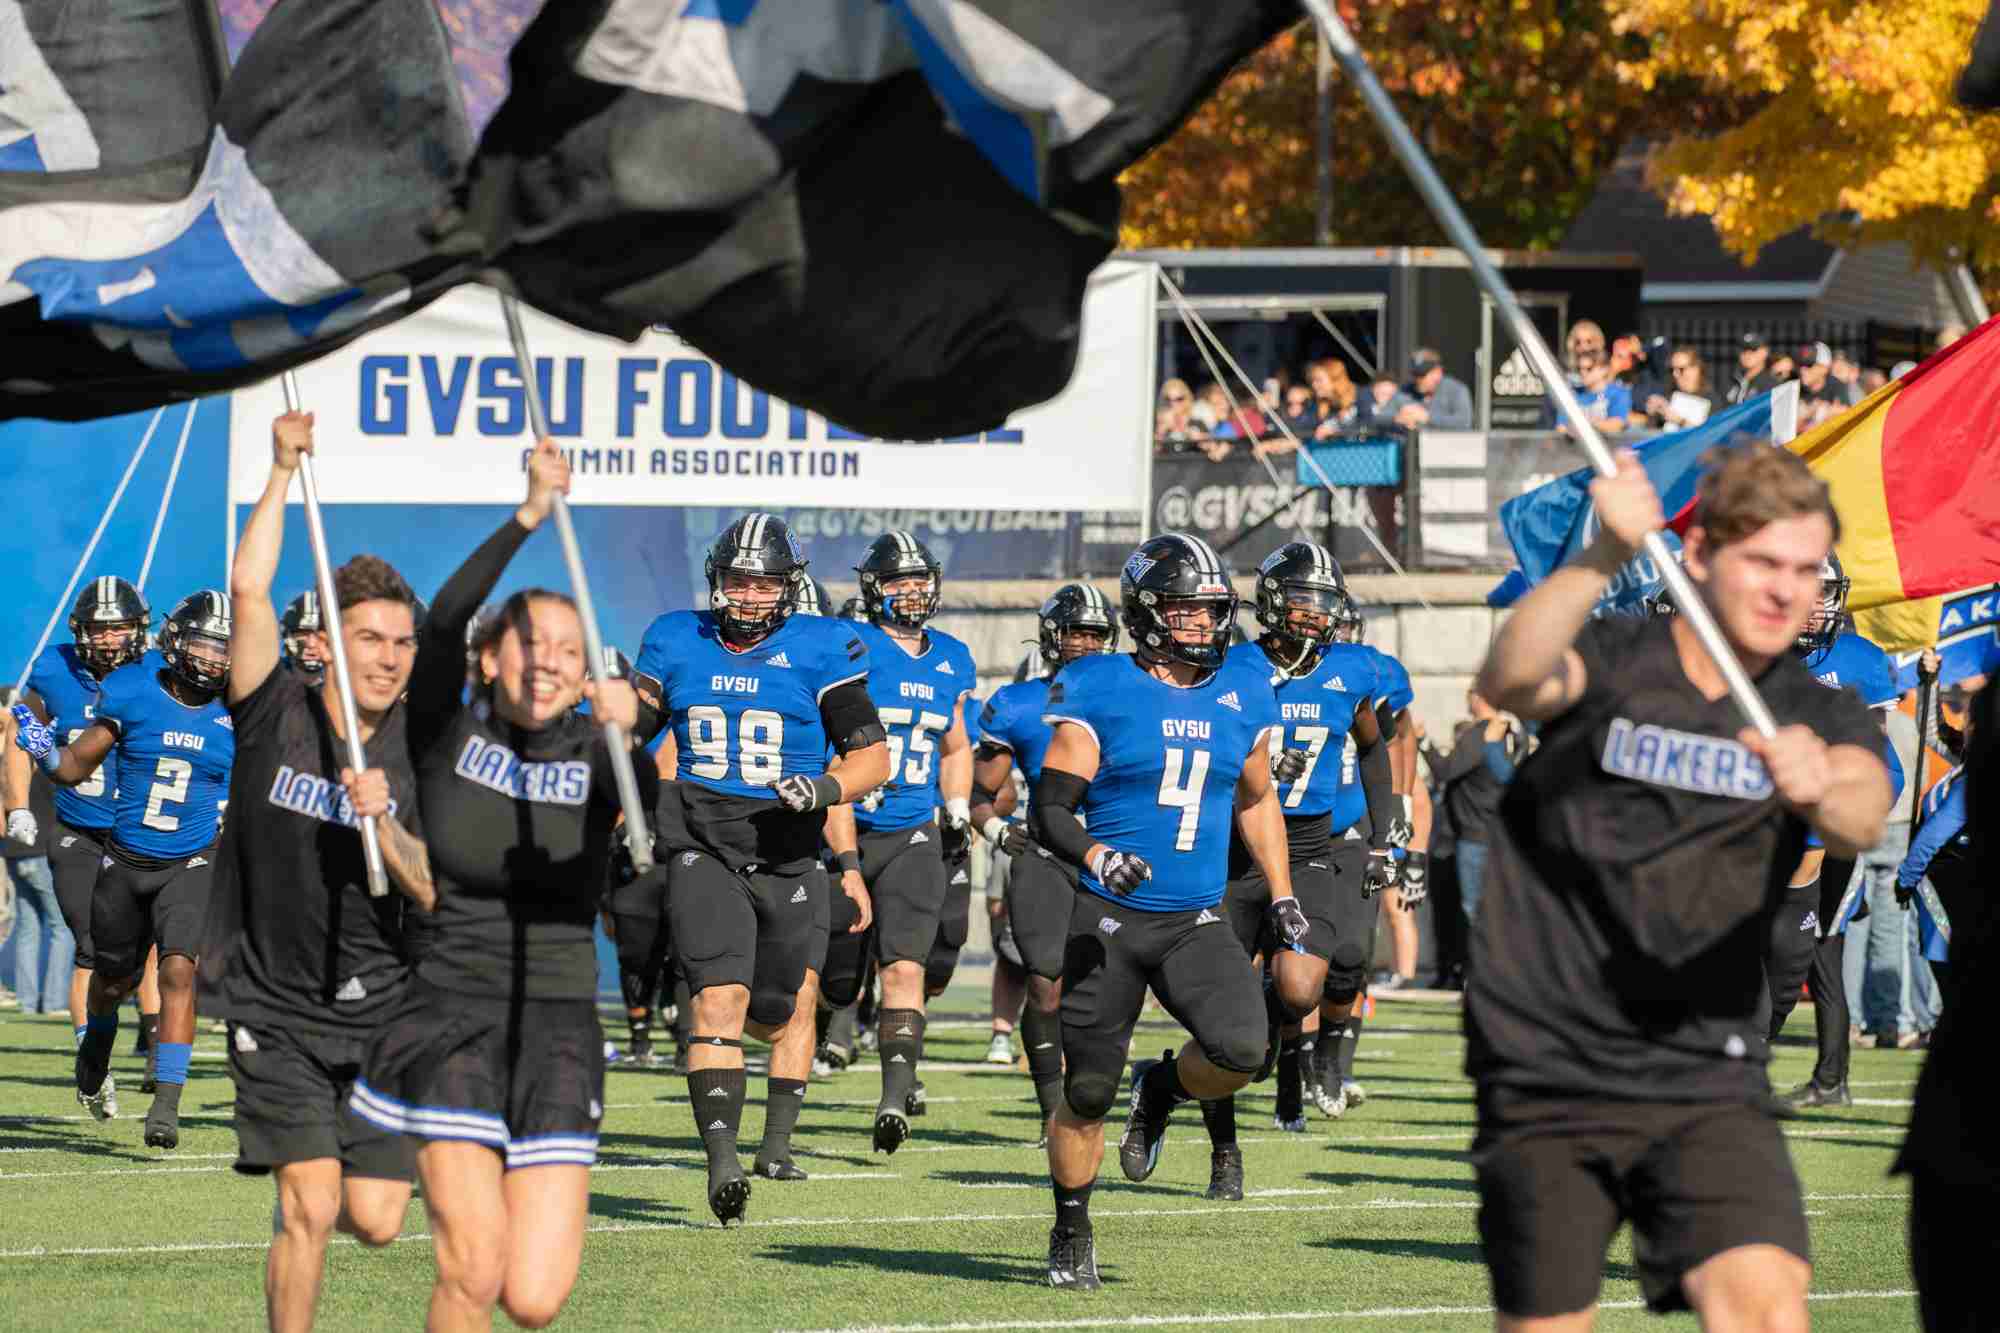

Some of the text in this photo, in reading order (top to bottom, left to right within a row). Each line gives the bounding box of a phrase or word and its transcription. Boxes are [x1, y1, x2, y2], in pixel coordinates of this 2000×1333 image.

[359, 354, 585, 437] GVSU
[650, 449, 860, 477] ASSOCIATION
[711, 674, 760, 693] GVSU
[899, 681, 935, 700] GVSU
[1281, 703, 1321, 719] GVSU
[163, 731, 205, 750] GVSU
[688, 705, 784, 786] 98
[877, 707, 949, 785] 55
[1162, 719, 1210, 739] GVSU
[1601, 717, 1775, 800] LAKERS
[143, 757, 192, 832] 2
[455, 734, 591, 805] LAKERS
[1158, 748, 1210, 850] 4
